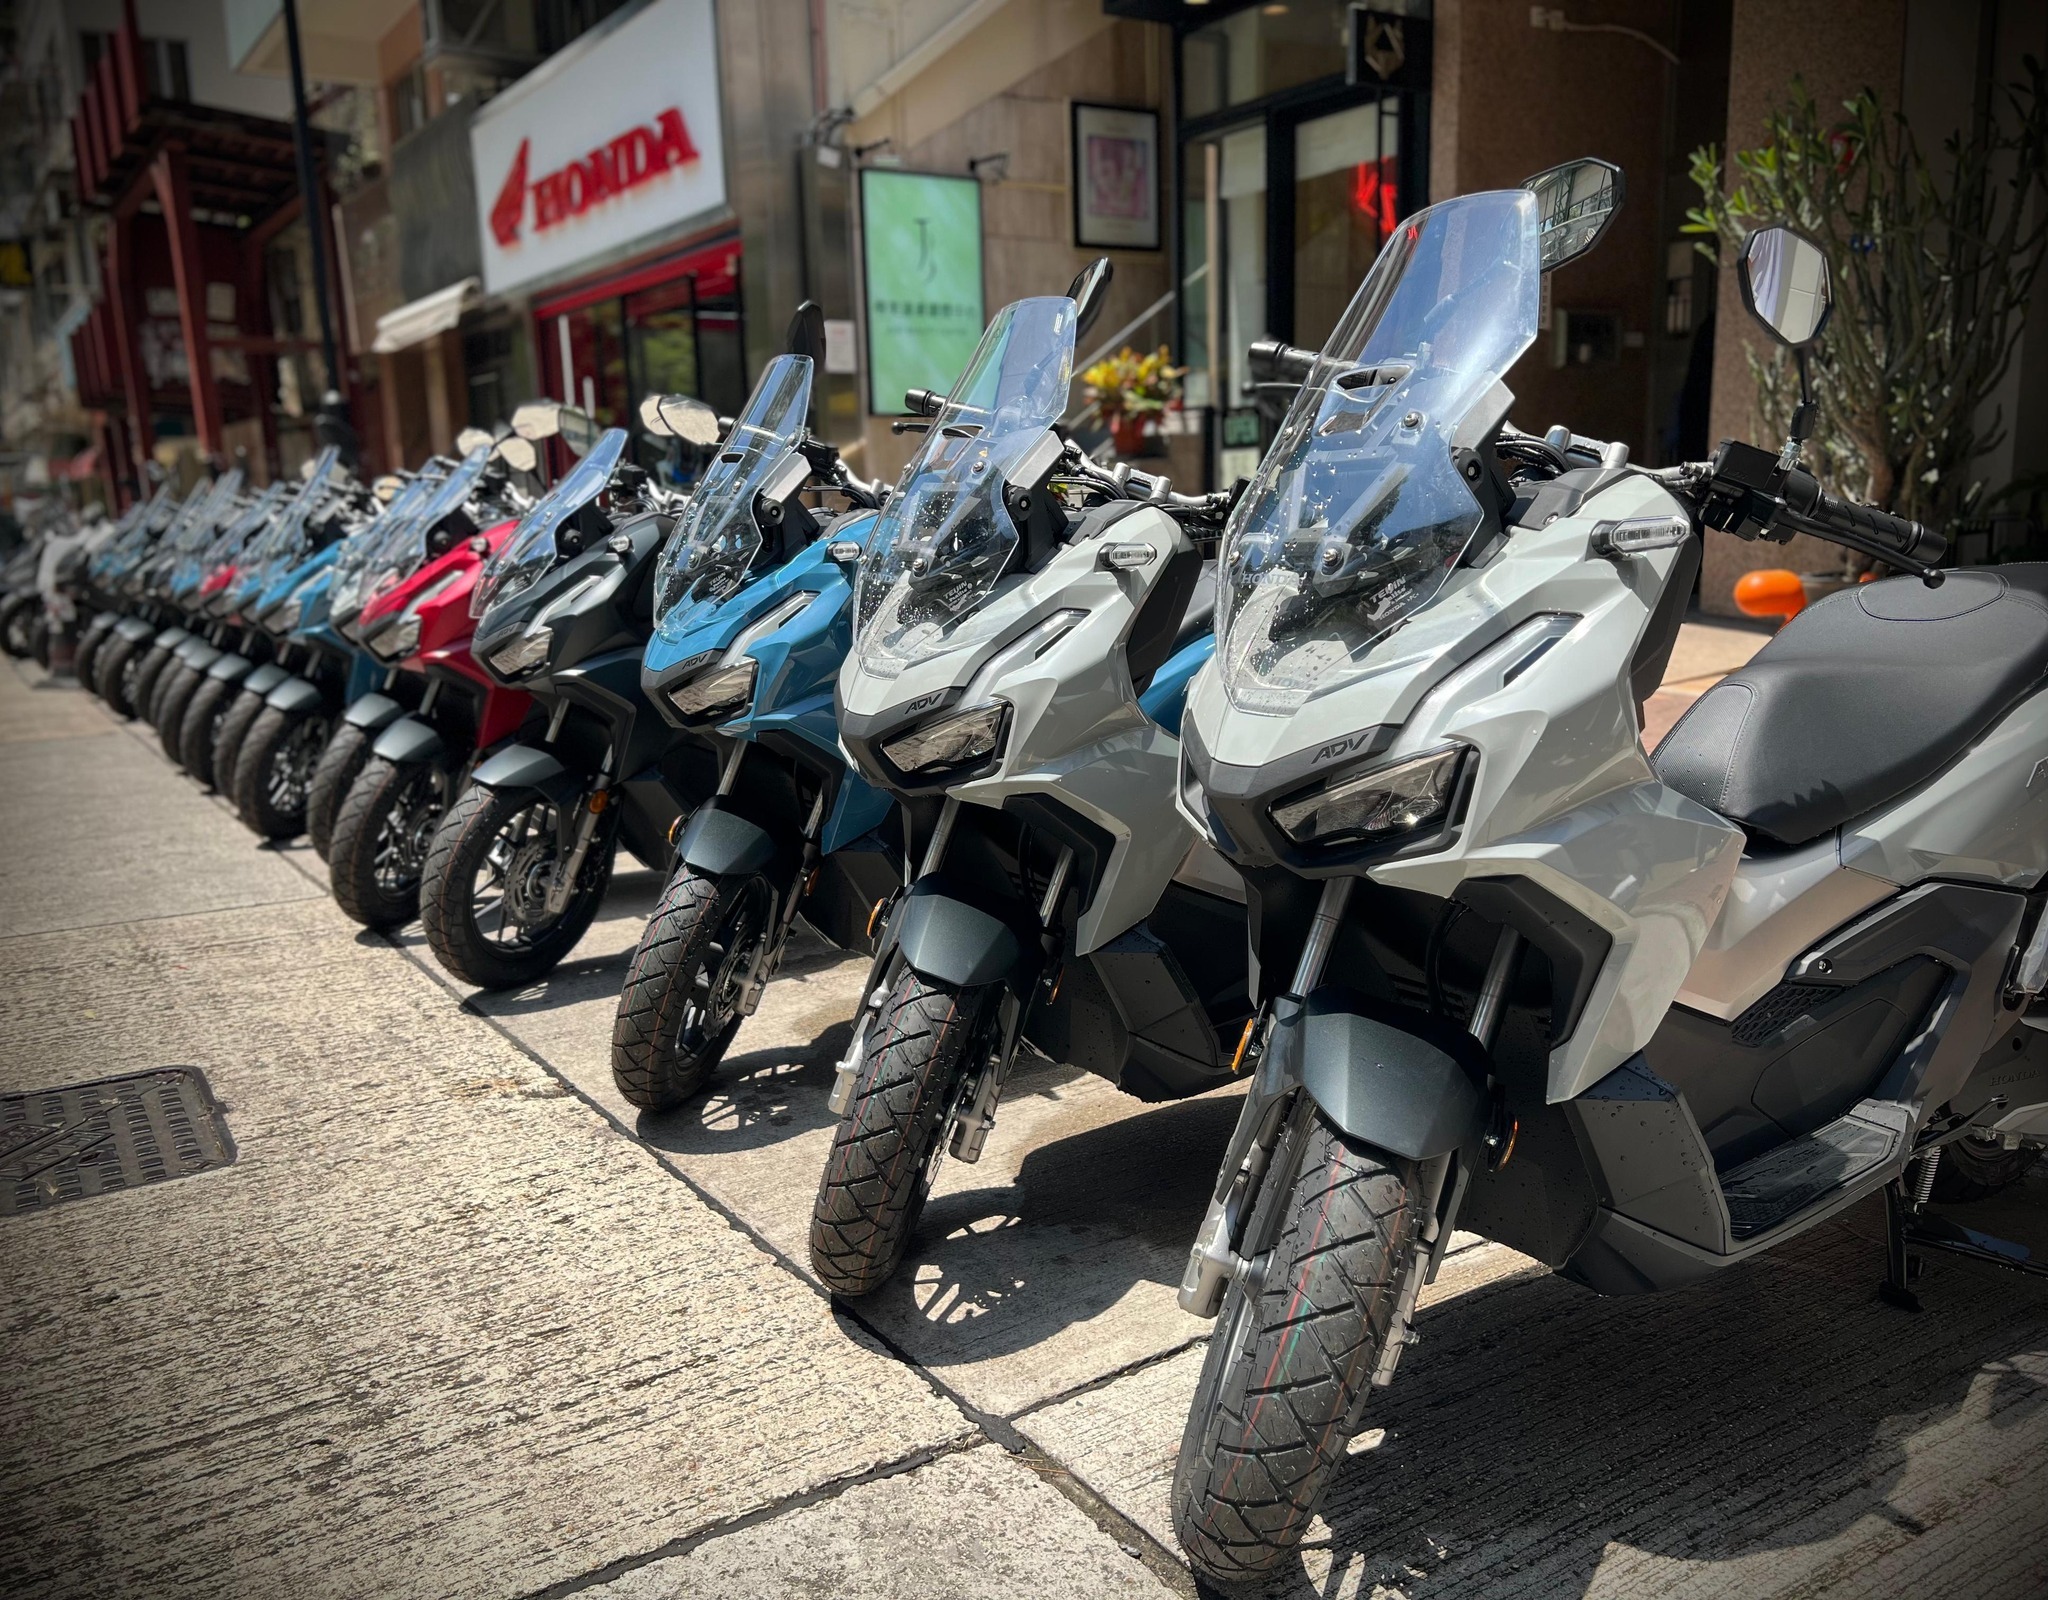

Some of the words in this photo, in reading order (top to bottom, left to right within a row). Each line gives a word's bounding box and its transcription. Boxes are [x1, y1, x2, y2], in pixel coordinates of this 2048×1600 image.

[532, 105, 700, 231] HONDA
[1241, 573, 1299, 585] HONDA
[682, 654, 708, 670] ADV
[904, 693, 943, 715] ADV
[1311, 733, 1370, 765] ADV
[1989, 1070, 2040, 1087] HONDA
